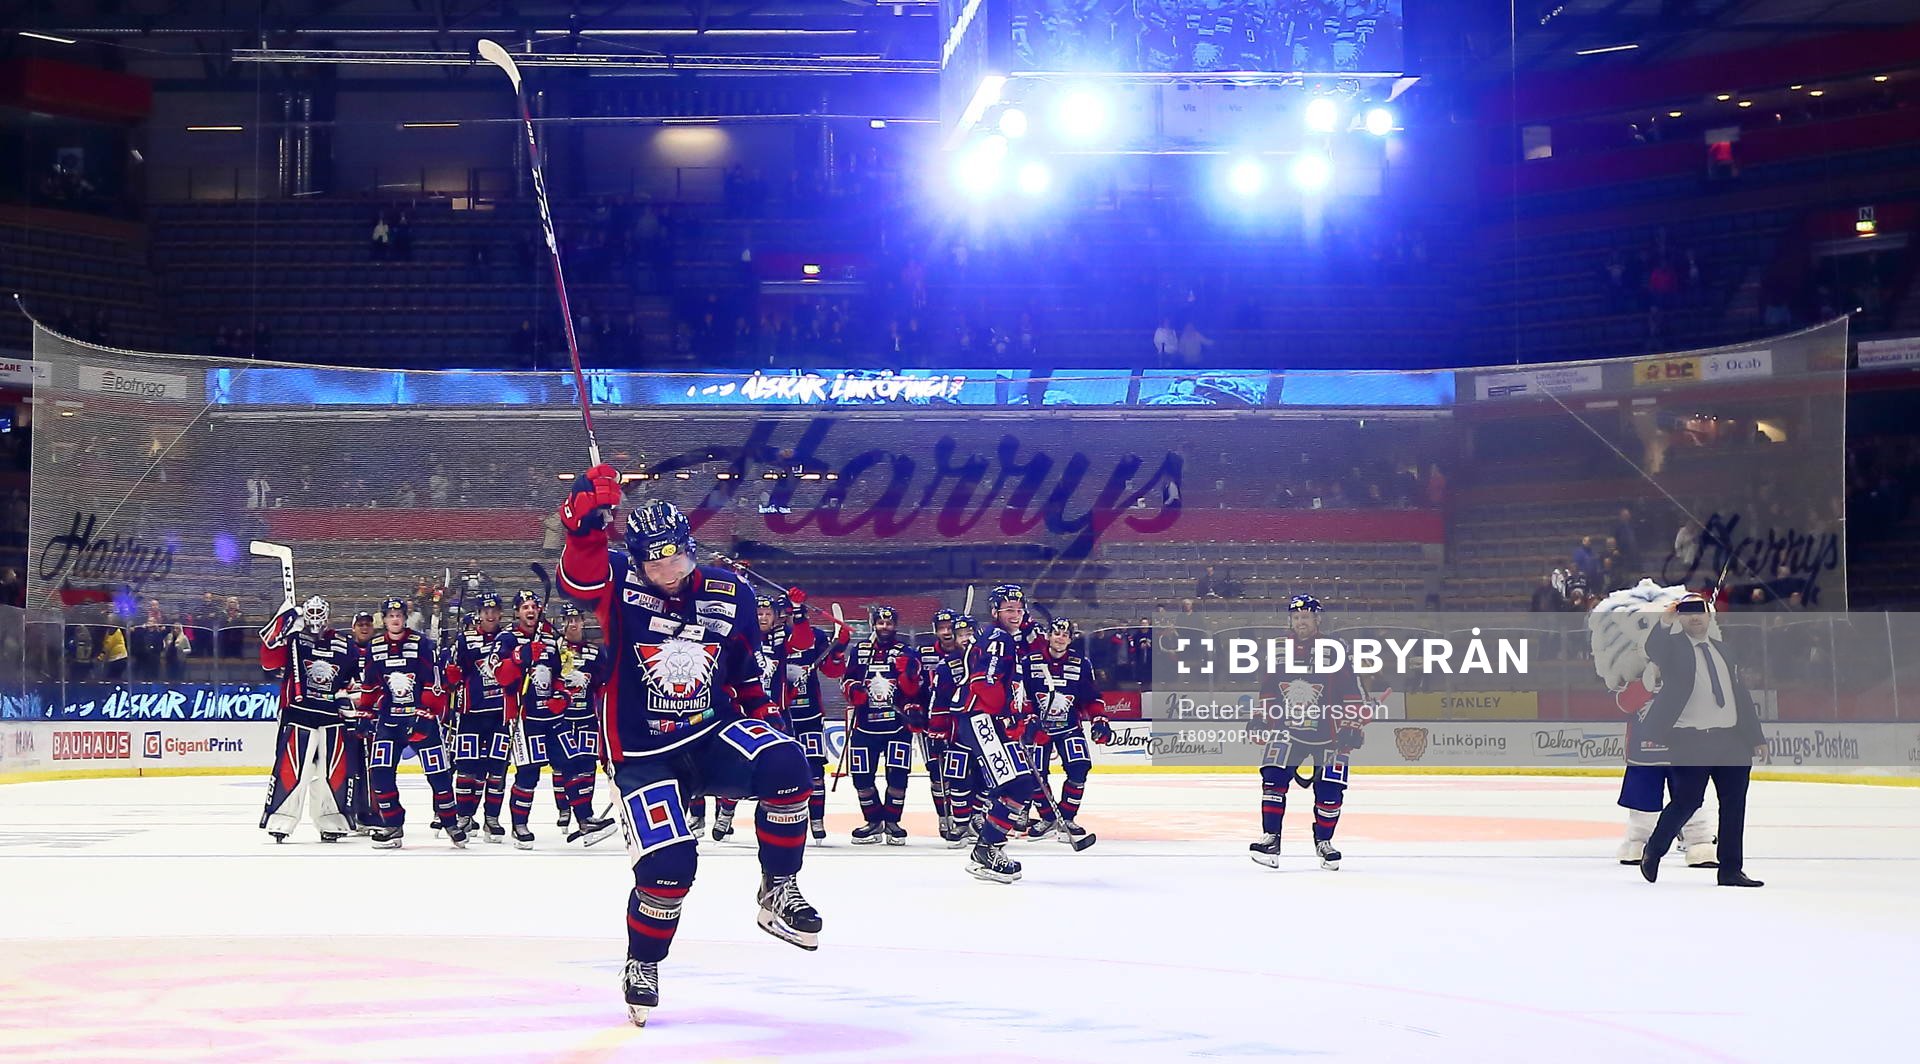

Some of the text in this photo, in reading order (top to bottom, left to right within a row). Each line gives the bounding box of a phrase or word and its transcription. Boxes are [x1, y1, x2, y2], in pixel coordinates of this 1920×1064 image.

[1726, 358, 1762, 371] Ocab
[115, 376, 166, 397] Botrygg
[610, 418, 1184, 600] Harrys
[40, 511, 174, 597] Harrys
[638, 600, 660, 611] SPORT
[640, 594, 664, 606] INTER
[986, 640, 1005, 657] 41
[1441, 696, 1501, 708] STANLEY
[975, 717, 994, 745] RÖR
[1432, 733, 1506, 749] Linköping
[1535, 729, 1583, 750] Dekor
[52, 731, 132, 761] BAUHAUS
[165, 737, 243, 756] GigantPrint
[1147, 733, 1208, 756] Reklam
[1579, 739, 1625, 760] Rekla
[1760, 730, 1859, 765] pings-Posten
[989, 750, 1009, 780] RÖR
[267, 775, 278, 806] CCM
